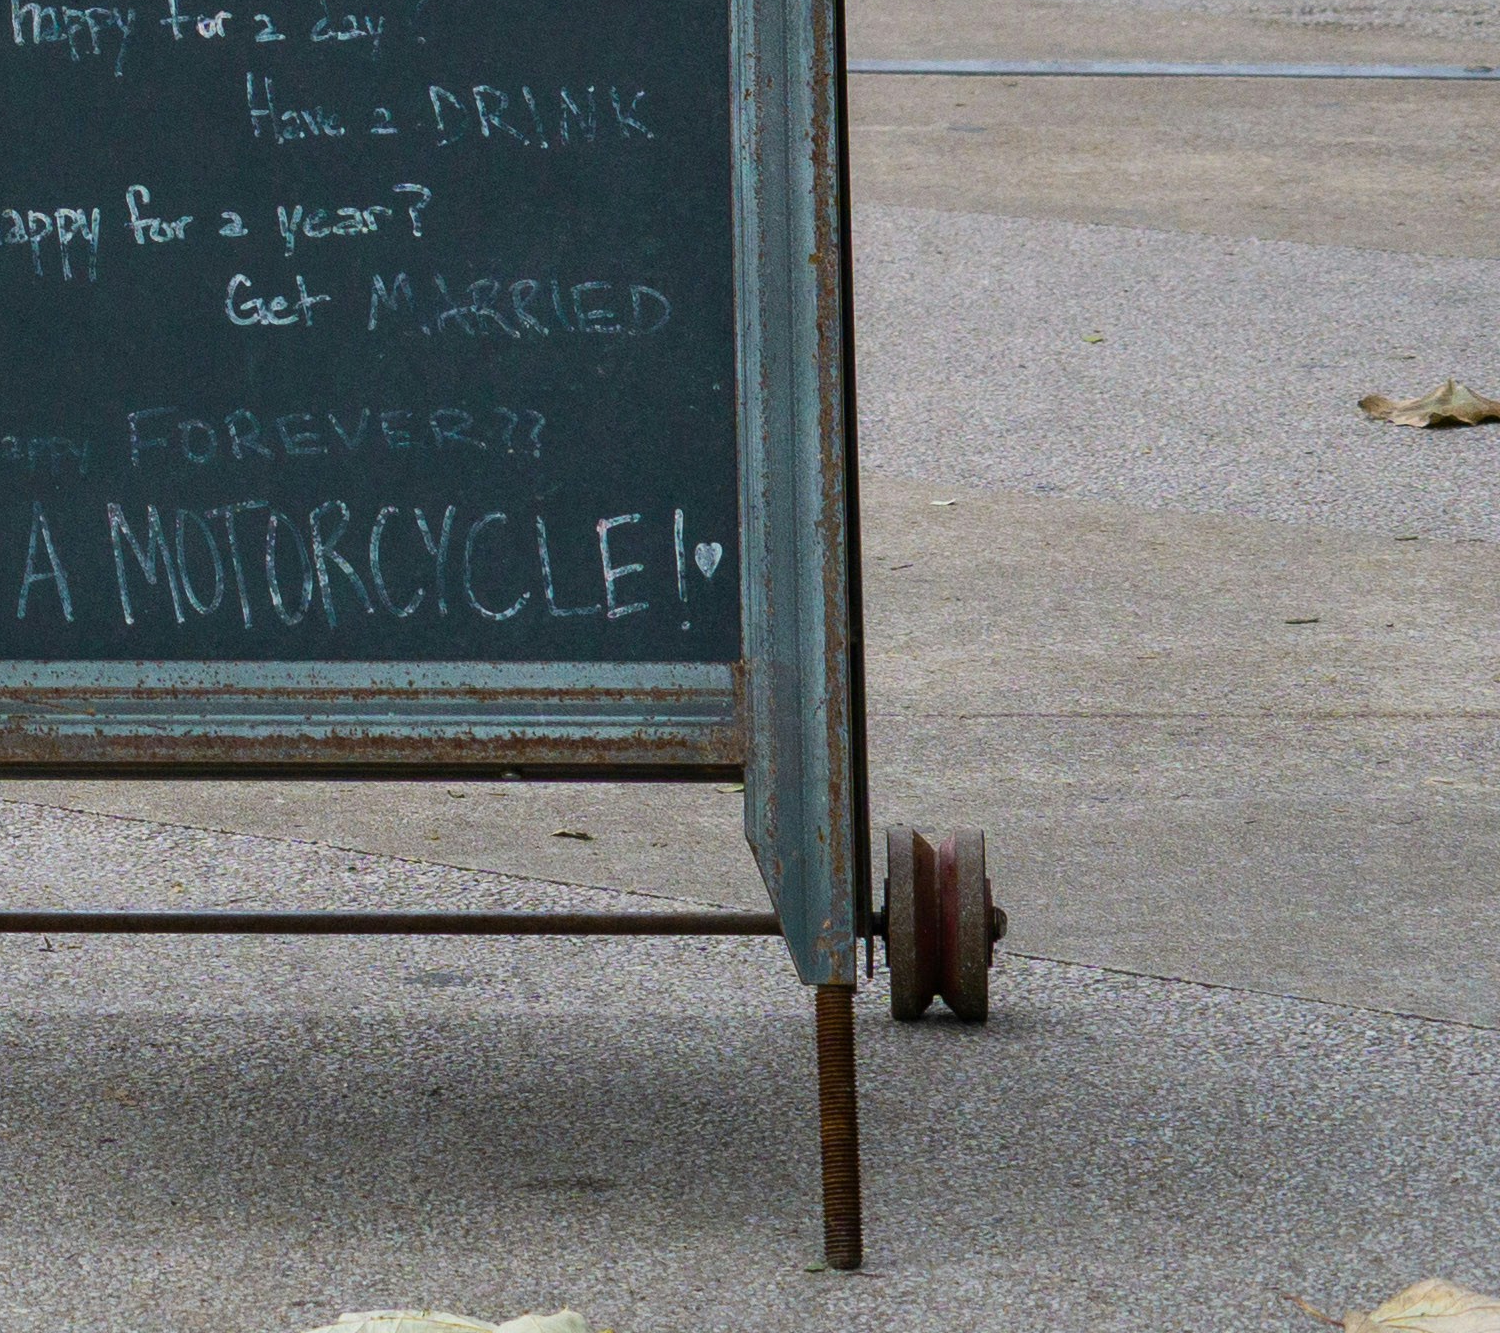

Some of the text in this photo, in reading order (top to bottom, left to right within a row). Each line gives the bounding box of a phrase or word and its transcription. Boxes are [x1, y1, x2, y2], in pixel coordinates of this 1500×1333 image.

[246, 71, 346, 146] Have
[428, 84, 656, 150] DRINK
[123, 183, 195, 245] for
[276, 182, 434, 258] year?
[224, 271, 674, 339] Get MARRIED
[16, 500, 76, 624] A
